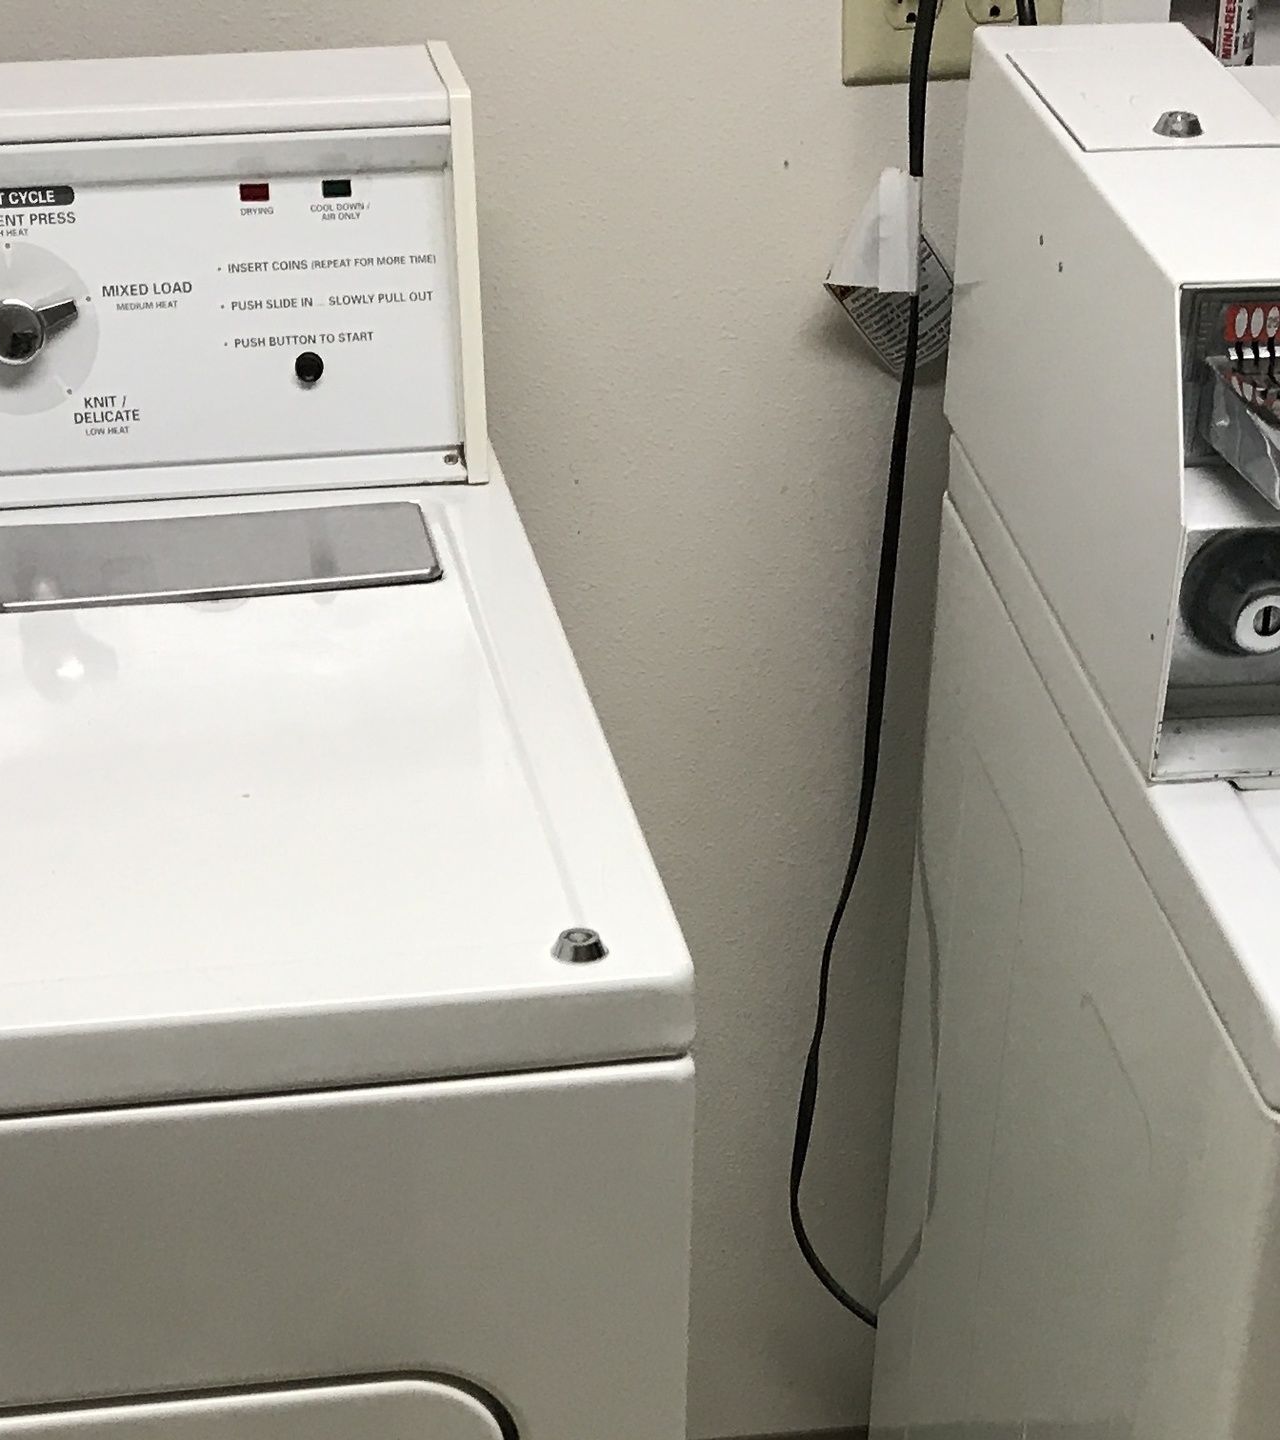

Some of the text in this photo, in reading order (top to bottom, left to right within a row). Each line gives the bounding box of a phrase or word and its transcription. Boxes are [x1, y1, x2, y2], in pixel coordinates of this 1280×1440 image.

[9, 191, 55, 205] CYCLE
[241, 207, 274, 216] DRYING
[310, 203, 364, 213] COOL DOWN
[30, 212, 76, 225] PRESS
[322, 212, 361, 221] AIR ONLY
[7, 229, 28, 237] HEAT
[228, 254, 437, 273] INSERT COINS (REPEAT FOR MORE TIME)
[102, 281, 193, 297] MIXED LOAD
[117, 301, 178, 311] MEDIUM HEAT
[231, 291, 433, 311] PUSH SLIDE IN SLOWLY PULL OUT
[235, 332, 374, 348] PUSH BUTTON TO START
[84, 396, 117, 409] KNIT
[74, 409, 140, 425] DELICATE
[86, 426, 130, 436] LOW HEAT
